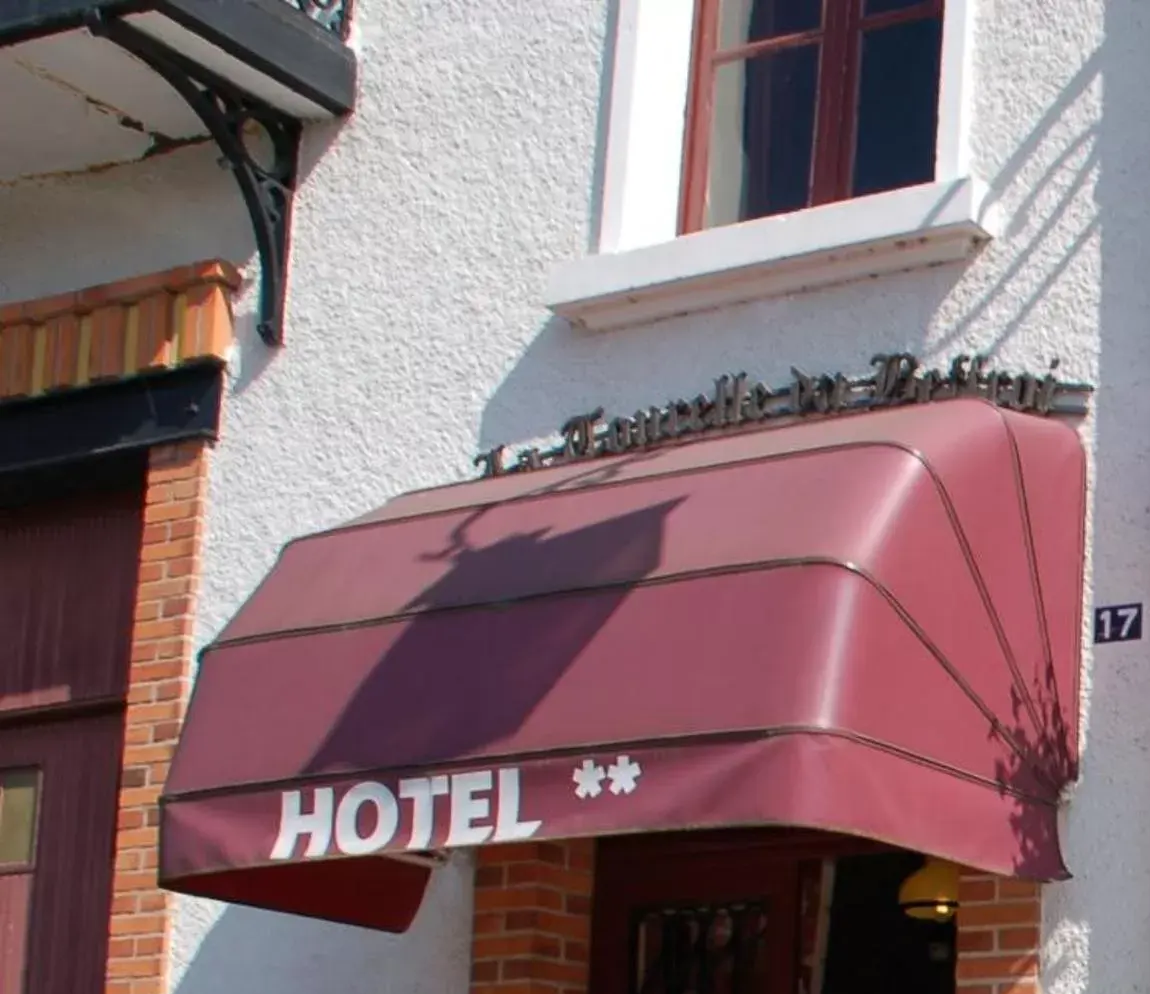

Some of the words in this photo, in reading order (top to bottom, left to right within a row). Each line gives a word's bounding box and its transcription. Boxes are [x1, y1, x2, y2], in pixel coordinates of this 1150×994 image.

[474, 444, 542, 478] La
[561, 370, 773, 459] Tourelle
[1100, 607, 1138, 639] 17
[269, 766, 543, 860] HOTEL
